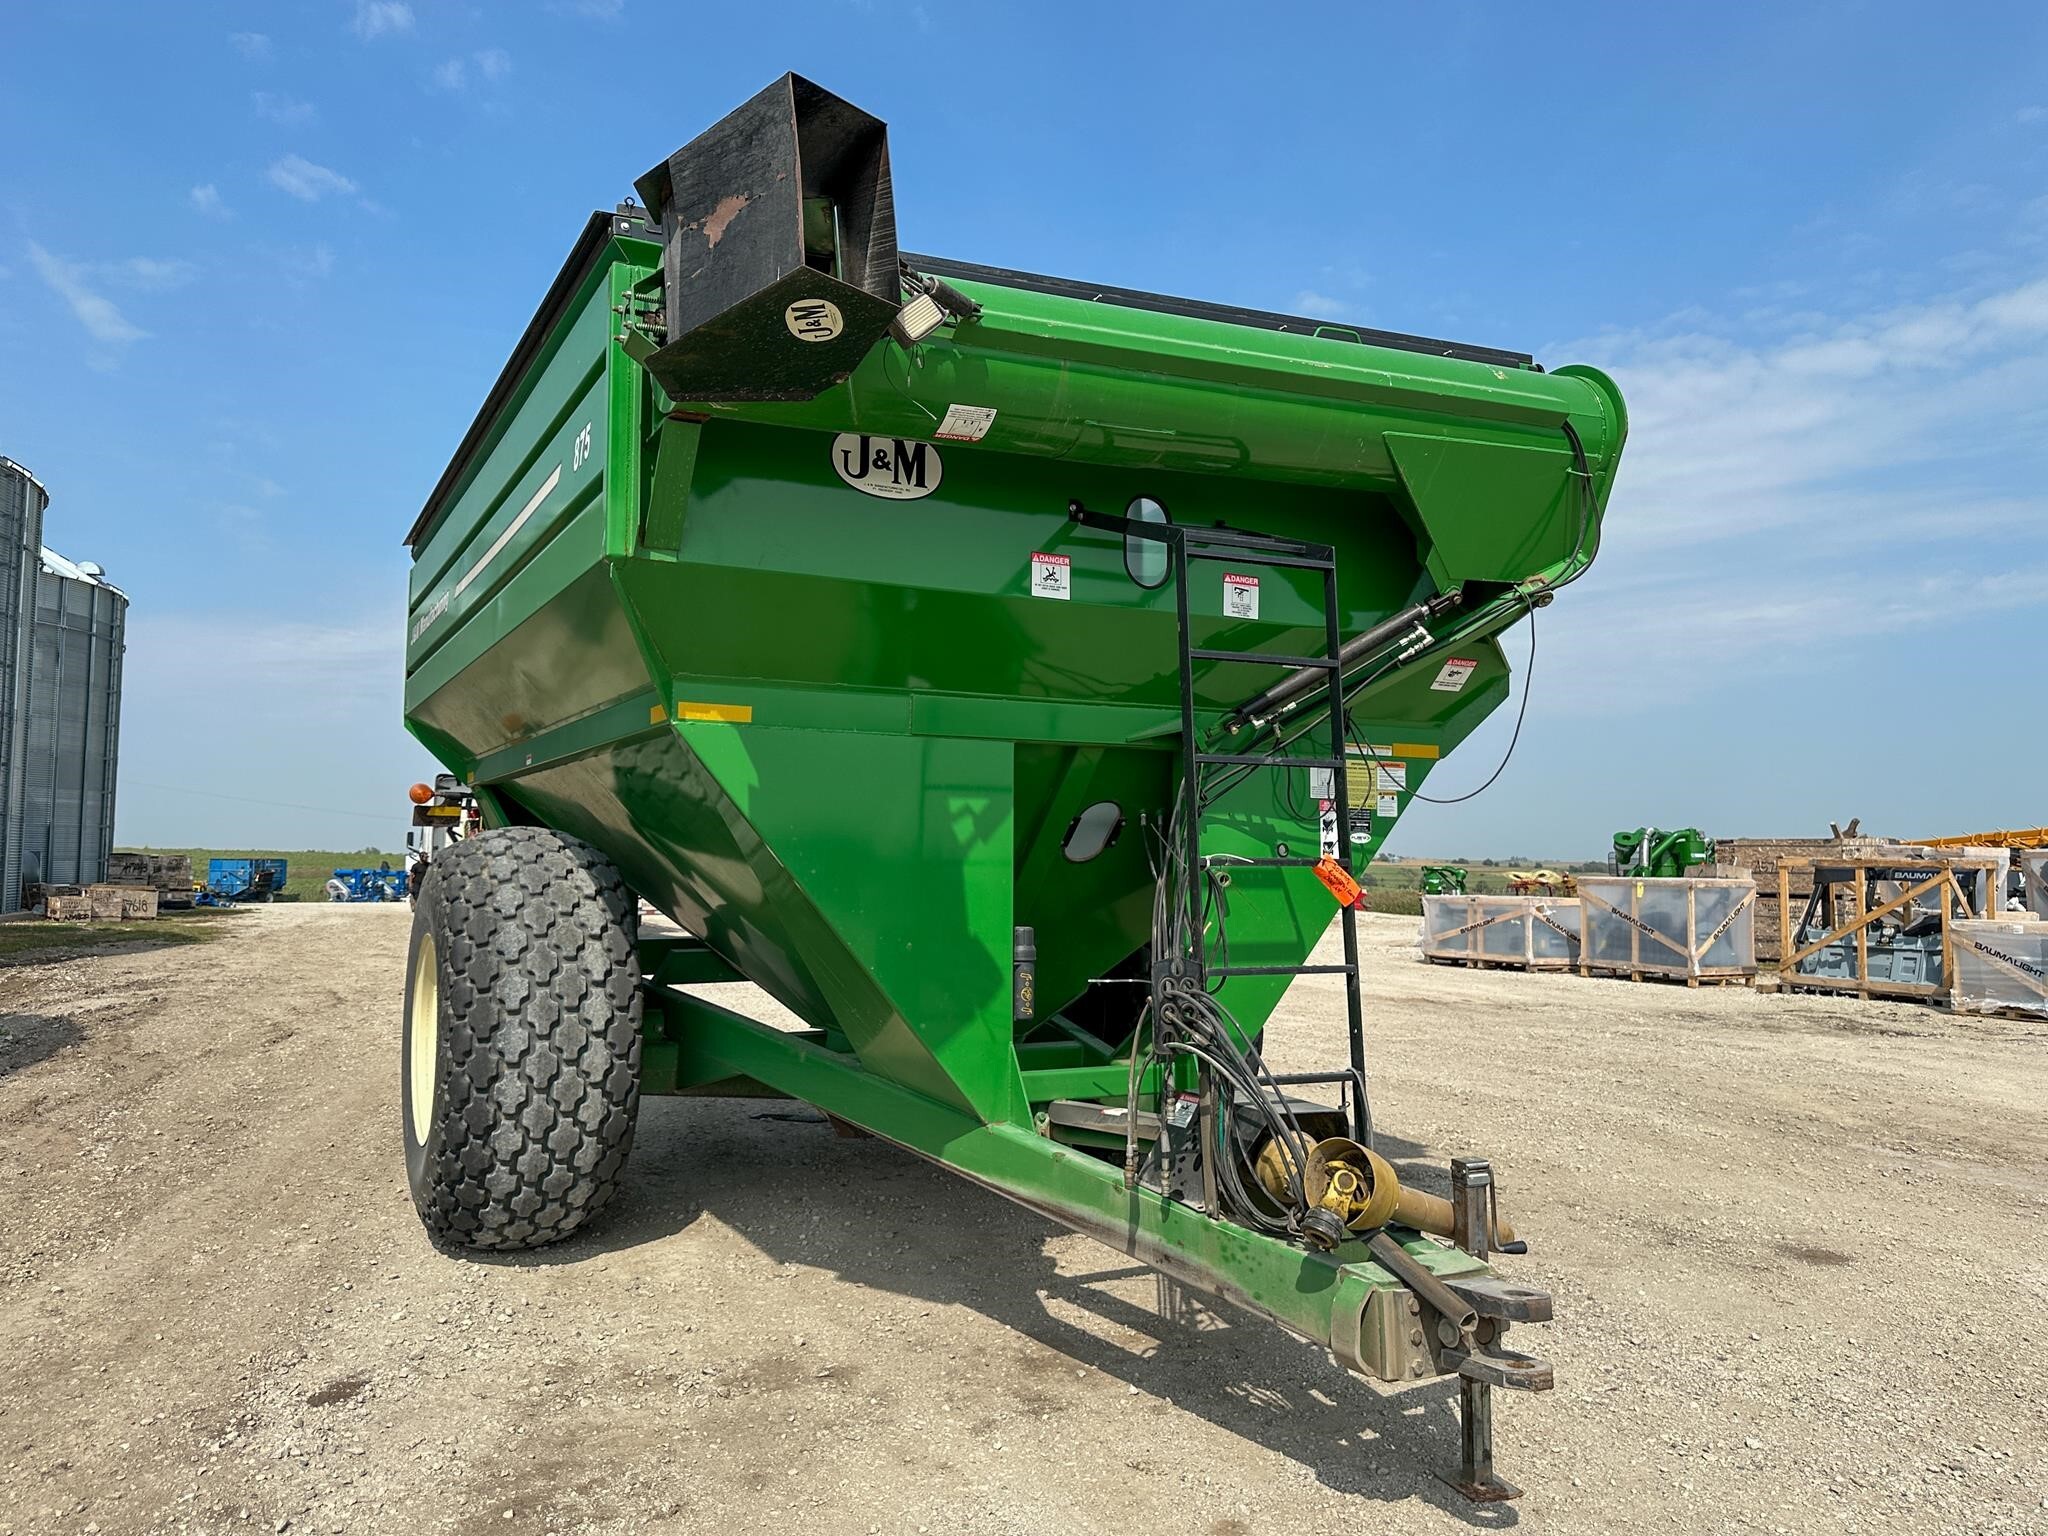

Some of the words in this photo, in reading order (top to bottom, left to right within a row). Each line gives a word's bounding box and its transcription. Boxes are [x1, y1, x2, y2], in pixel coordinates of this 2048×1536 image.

[791, 303, 833, 339] J&M
[573, 421, 591, 471] 875
[841, 436, 928, 488] J&M
[1040, 555, 1070, 565] DANGER
[1231, 575, 1259, 586] DANGER
[1612, 907, 1655, 935] BAUMALIGHT
[1713, 902, 1745, 941] BAUMALIGHT
[1974, 941, 2045, 978] BAUMALIGHT
